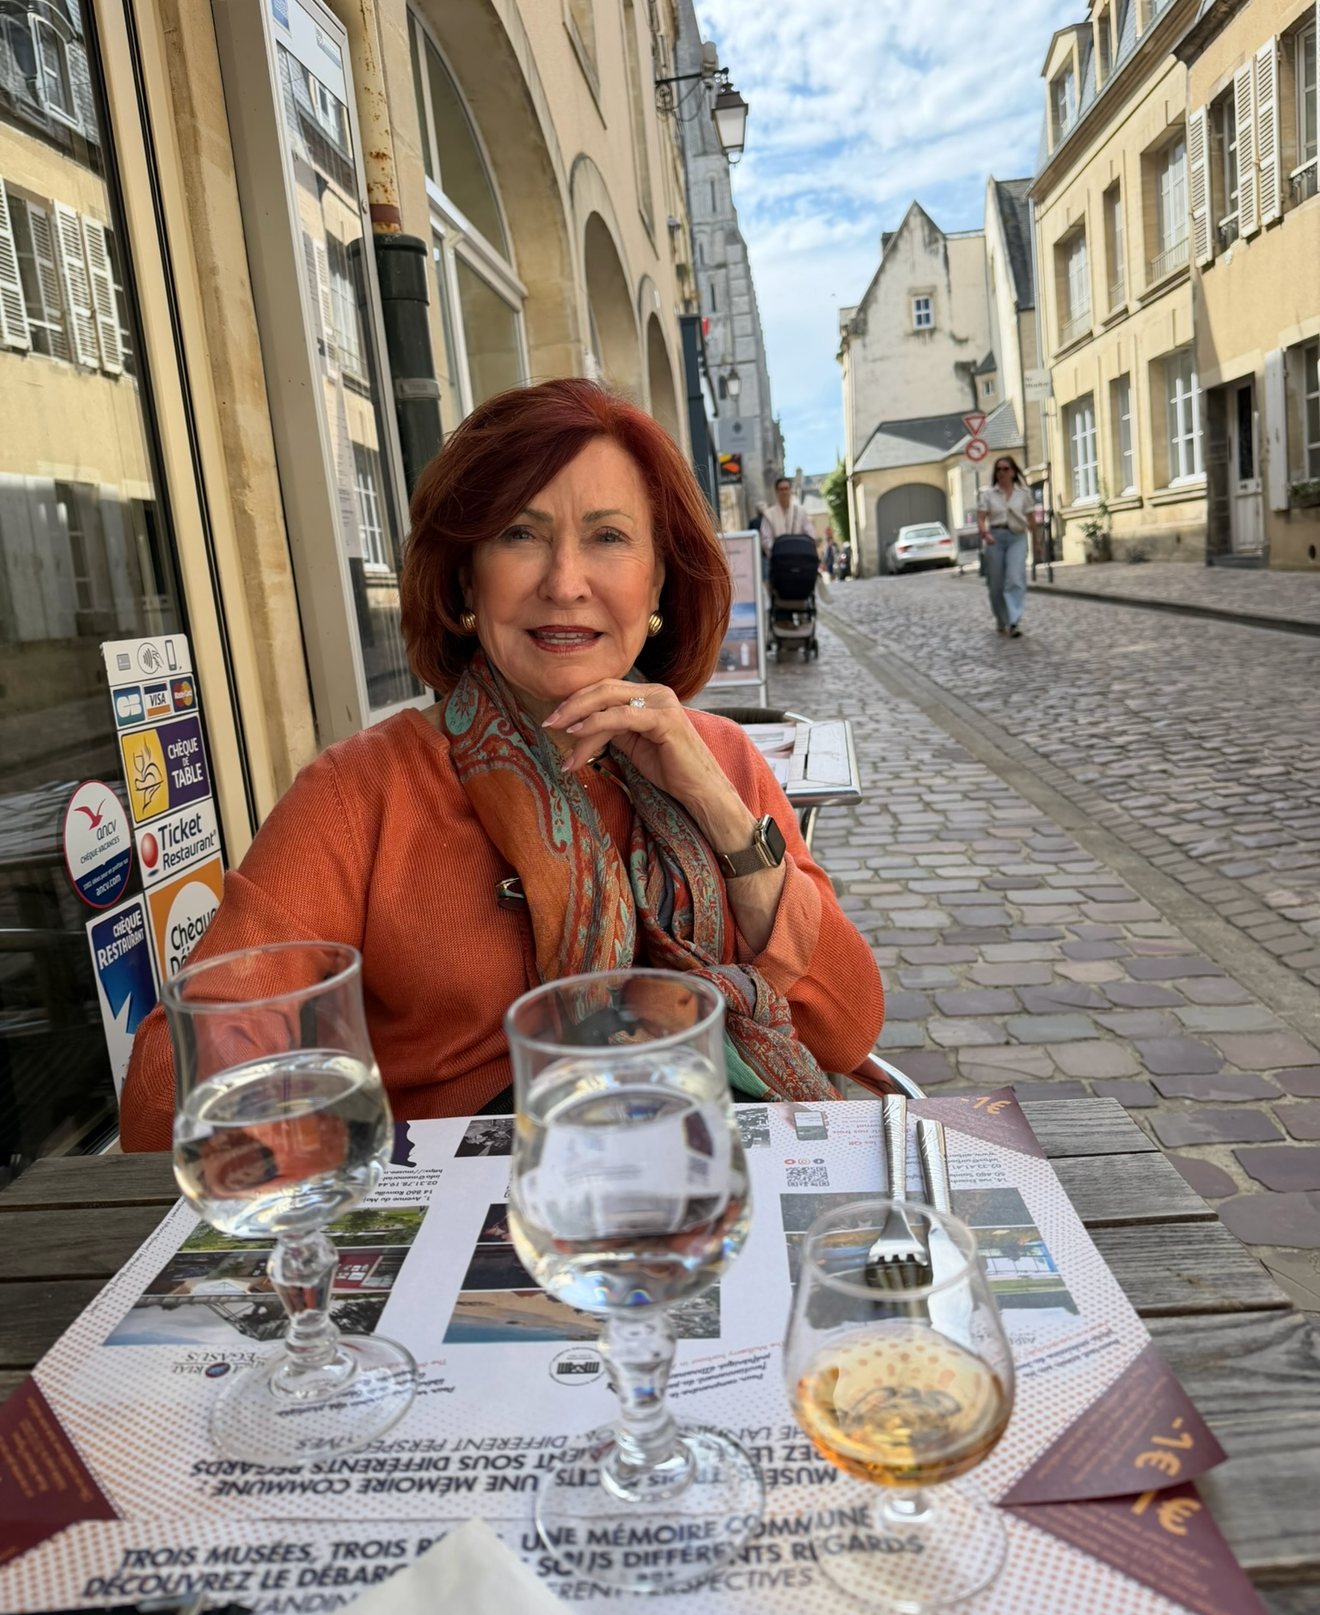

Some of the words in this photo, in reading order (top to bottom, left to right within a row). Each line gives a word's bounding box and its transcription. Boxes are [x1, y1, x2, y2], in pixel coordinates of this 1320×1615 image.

[116, 693, 142, 718] CB
[149, 692, 166, 707] VISA
[167, 737, 199, 759] CHÈQUE
[181, 757, 189, 766] DE
[171, 763, 204, 789] TABLE
[96, 819, 117, 841] ancv
[158, 812, 203, 851] Ticket
[95, 873, 122, 897] ancv.com
[112, 909, 143, 938] CHÈQUE
[97, 928, 145, 971] RESTAURANT
[450, 1435, 567, 1454] DIFFERENT
[311, 1456, 450, 1476] DIFFÉRENTS
[452, 1453, 526, 1472] SOUS
[211, 1478, 351, 1497] COMMUNE
[357, 1475, 478, 1497] MÉMOIRE
[484, 1473, 538, 1492] UNE
[121, 1548, 197, 1569] TROIS
[203, 1541, 319, 1567] MUSÉES,
[329, 1540, 406, 1561] TROIS
[586, 1521, 717, 1547] MÉMOIRE
[84, 1571, 252, 1598] DÉCOUVREZ
[260, 1570, 291, 1590] LE
